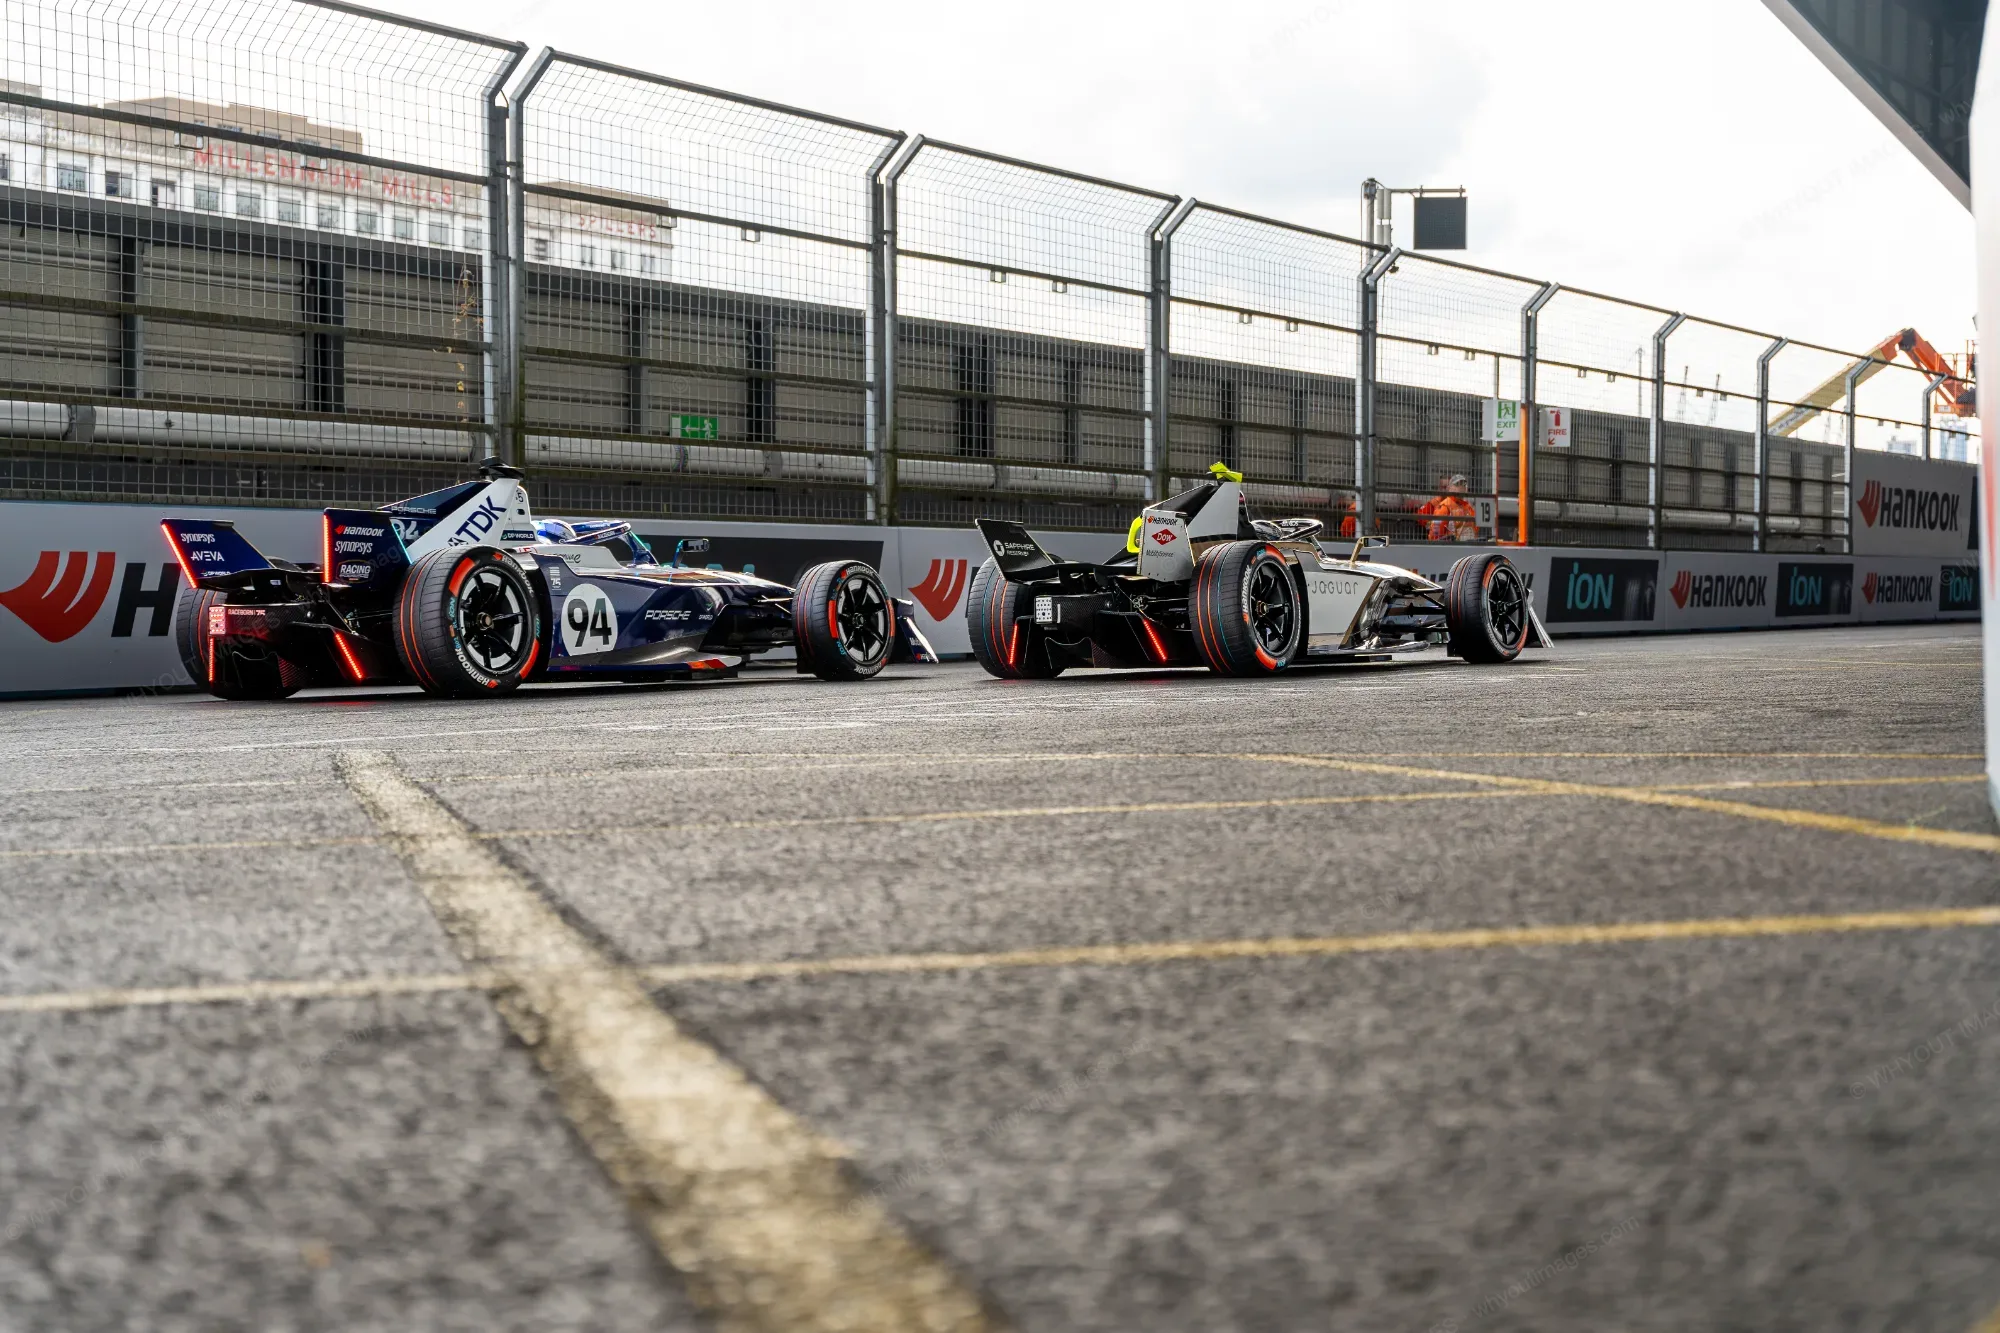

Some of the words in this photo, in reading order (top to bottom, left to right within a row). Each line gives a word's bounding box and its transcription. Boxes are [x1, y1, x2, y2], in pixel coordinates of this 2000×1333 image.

[194, 144, 363, 190] MILLENNIUM
[382, 174, 453, 205] MILLS
[1496, 421, 1518, 429] EXIT
[1547, 428, 1568, 436] FIRE
[1480, 502, 1491, 522] 19
[1879, 486, 1960, 532] HANKOOK
[454, 495, 507, 543] TDK
[1152, 517, 1178, 526] HANKOOK
[343, 526, 385, 537] HANKOOK
[1157, 532, 1173, 542] DOW
[180, 533, 216, 544] SYNOPSYS
[334, 540, 373, 555] SYNOPSYS
[1004, 542, 1036, 551] SAPPHIRE
[190, 551, 225, 562] AVEVA
[340, 564, 371, 574] RACING
[550, 577, 561, 586] 75
[1241, 564, 1252, 613] HANKOOK
[1689, 574, 1768, 608] HANKOOK
[1875, 575, 1933, 604] HANKOOK
[644, 609, 692, 621] PORSCHE
[567, 598, 612, 647] 94
[454, 647, 490, 687] HANKOOK
